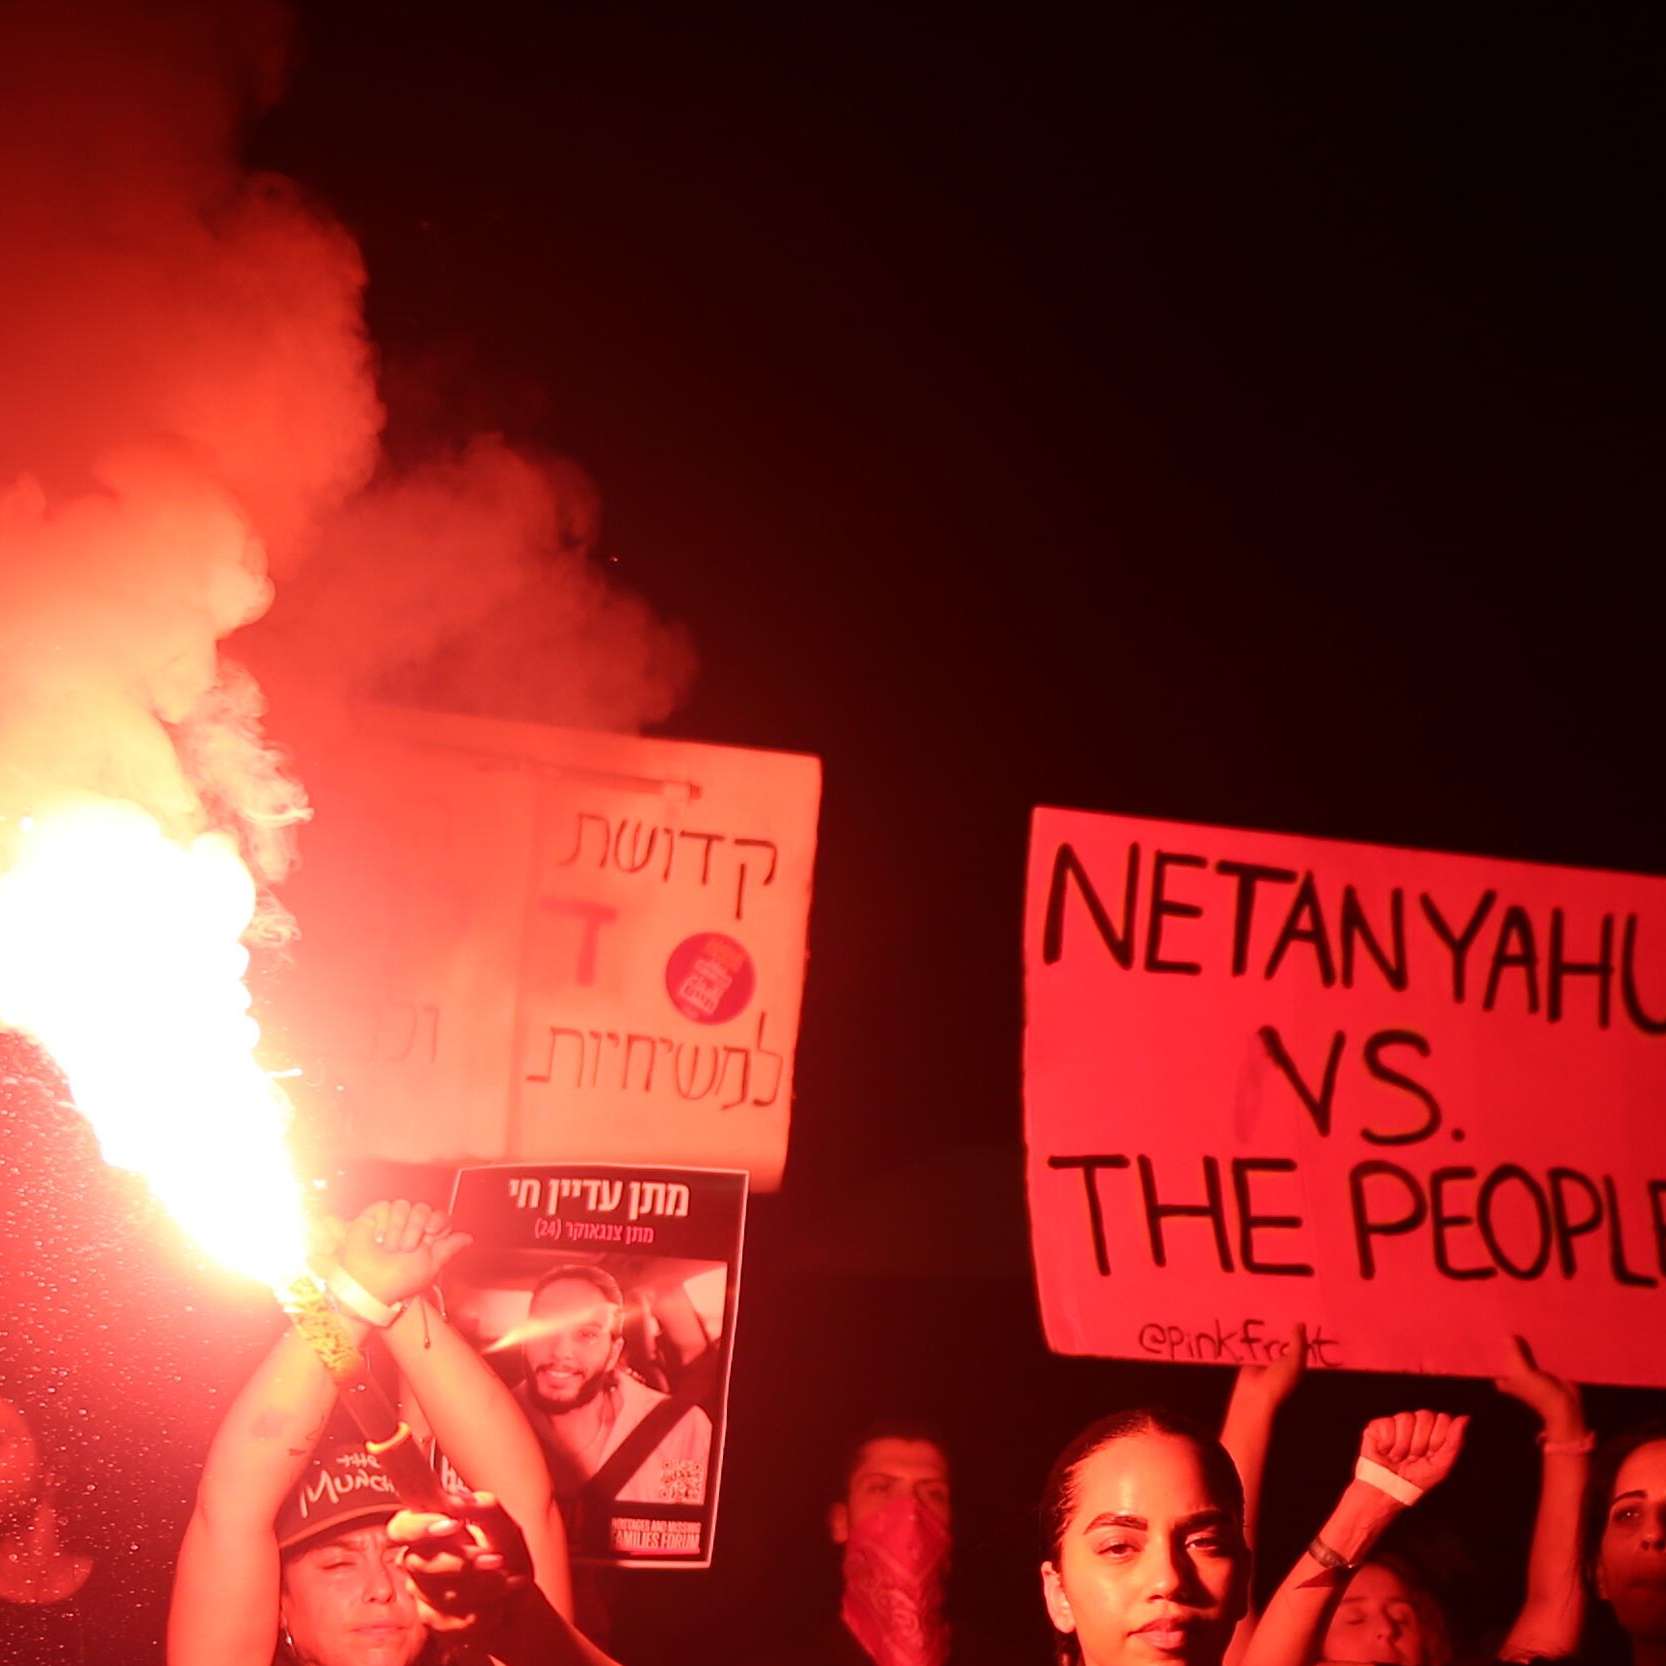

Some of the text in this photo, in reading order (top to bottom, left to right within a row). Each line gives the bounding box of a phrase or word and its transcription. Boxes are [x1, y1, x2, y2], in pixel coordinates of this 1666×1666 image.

[555, 811, 780, 921] קדושת
[1258, 1025, 1466, 1146] VS.
[508, 1177, 690, 1221] מתן עדיין חי
[534, 1217, 561, 1239] (24)
[625, 1225, 654, 1245] מתן
[1048, 1154, 1313, 1277] THE
